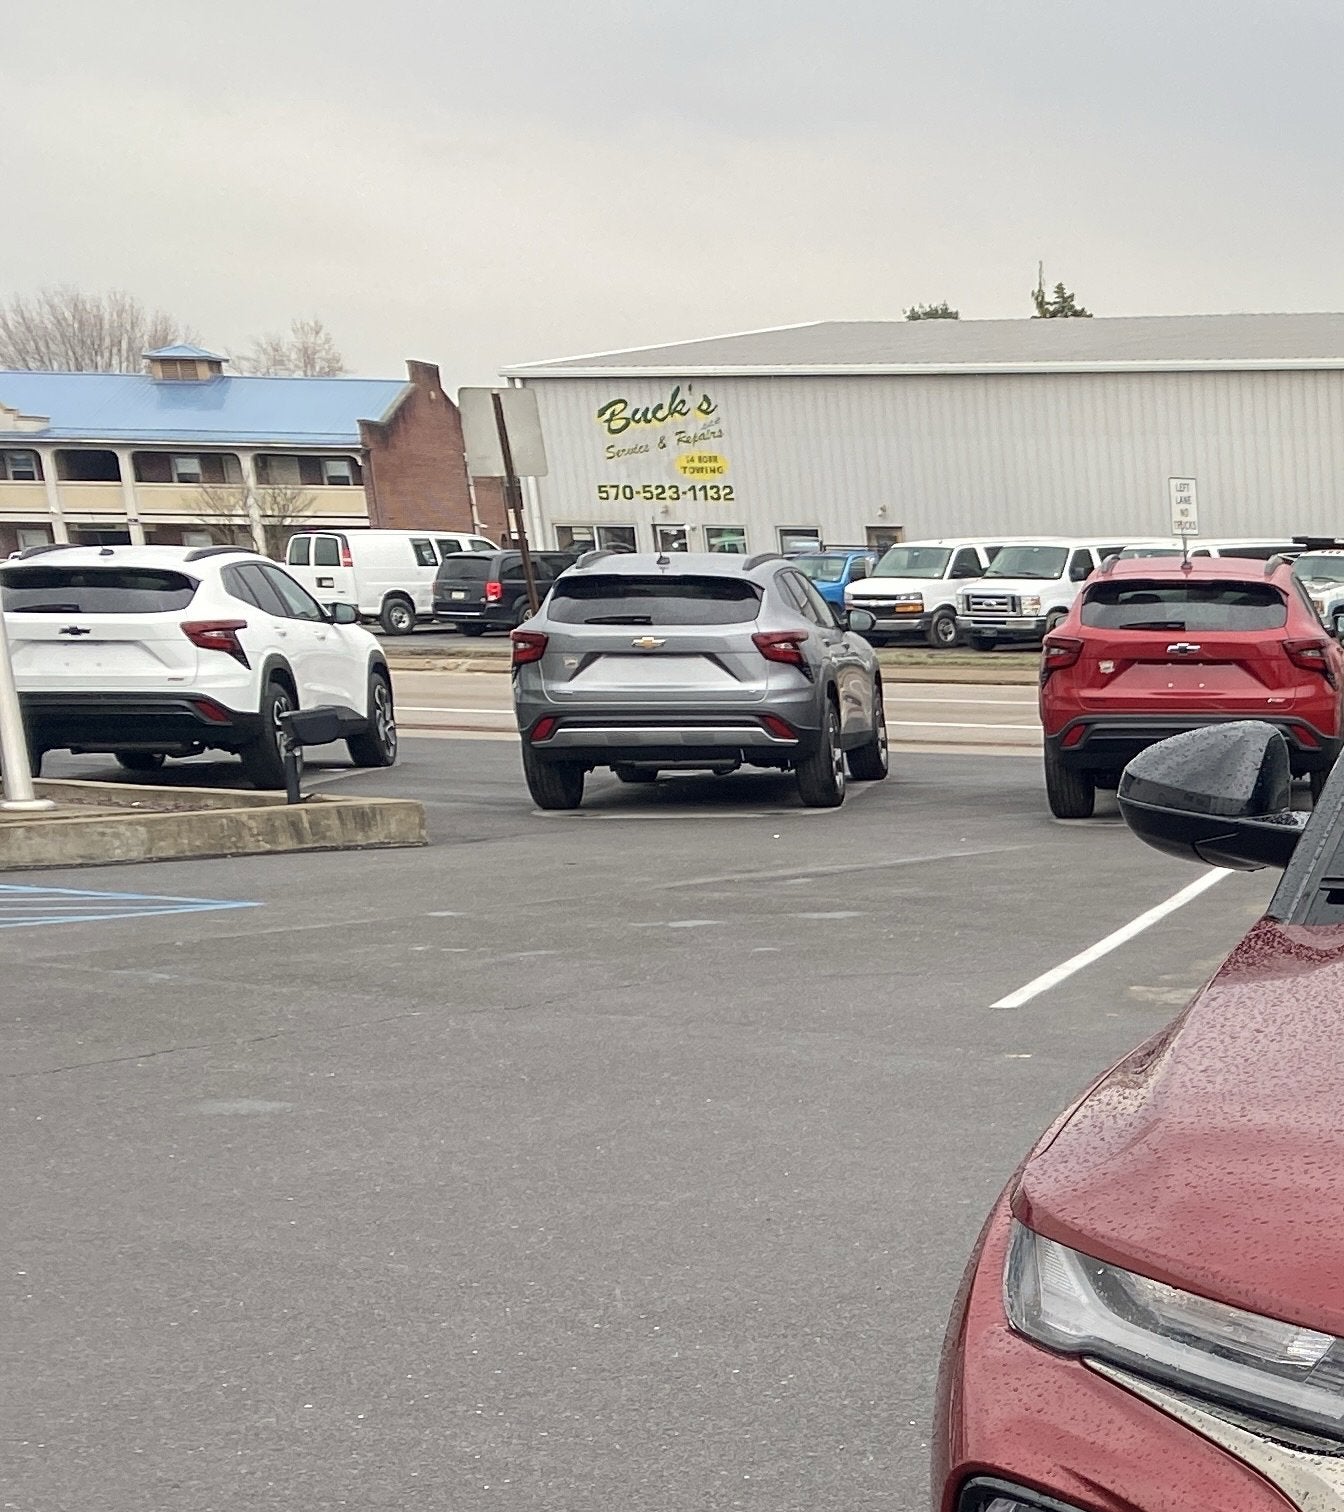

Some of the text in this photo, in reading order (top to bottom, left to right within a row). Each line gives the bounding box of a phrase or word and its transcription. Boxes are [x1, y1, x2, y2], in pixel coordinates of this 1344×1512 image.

[597, 384, 718, 434] Buck's
[657, 436, 666, 449] &
[674, 428, 724, 446] Repairs
[680, 466, 724, 474] TOWING
[597, 485, 735, 501] 570-523-1132
